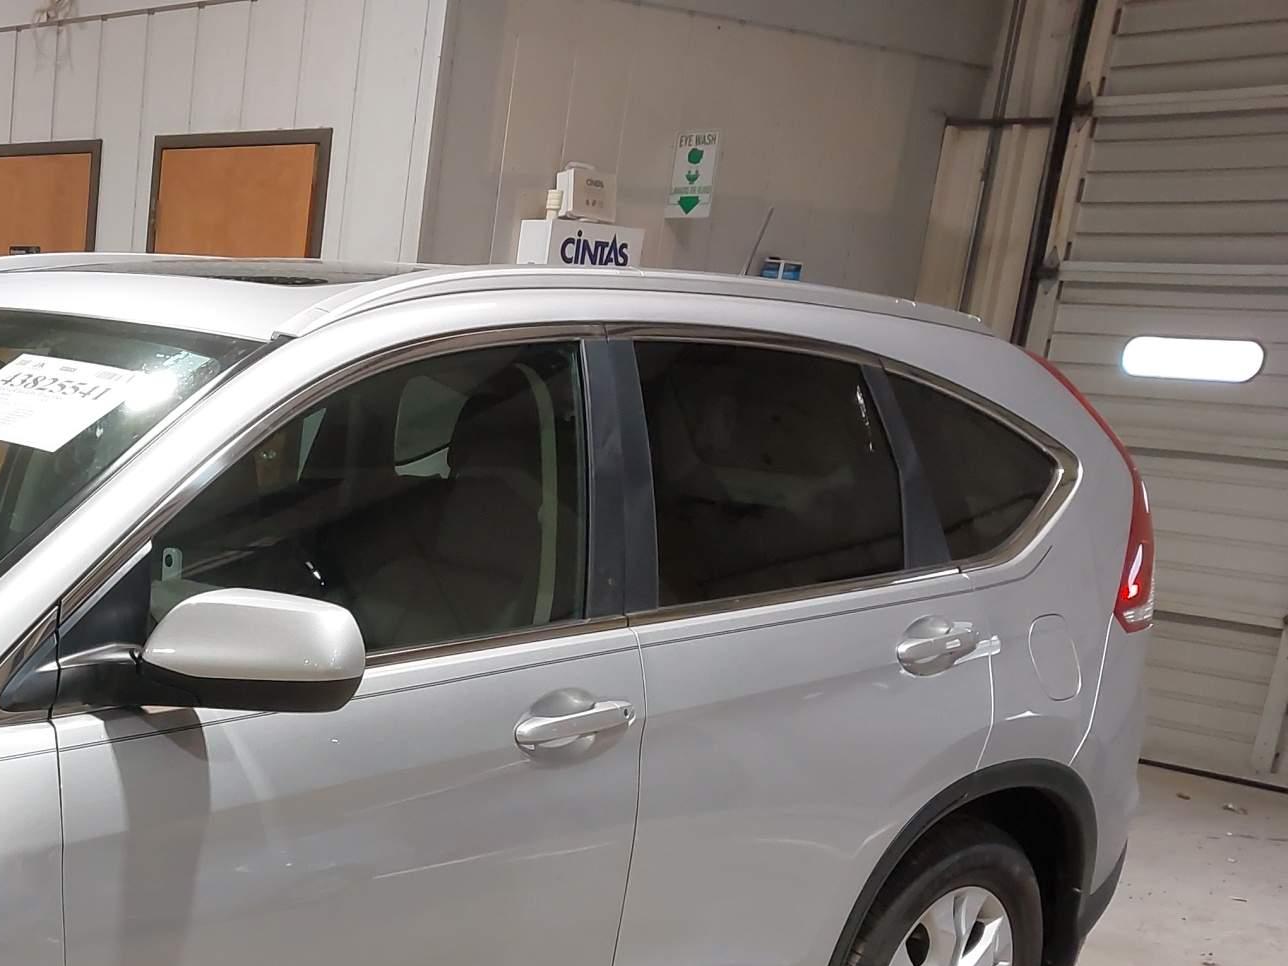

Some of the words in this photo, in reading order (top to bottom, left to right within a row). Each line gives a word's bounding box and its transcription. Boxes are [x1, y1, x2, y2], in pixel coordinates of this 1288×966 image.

[678, 134, 695, 148] EYE
[695, 133, 717, 146] WASH
[0, 372, 112, 401] 43825541
